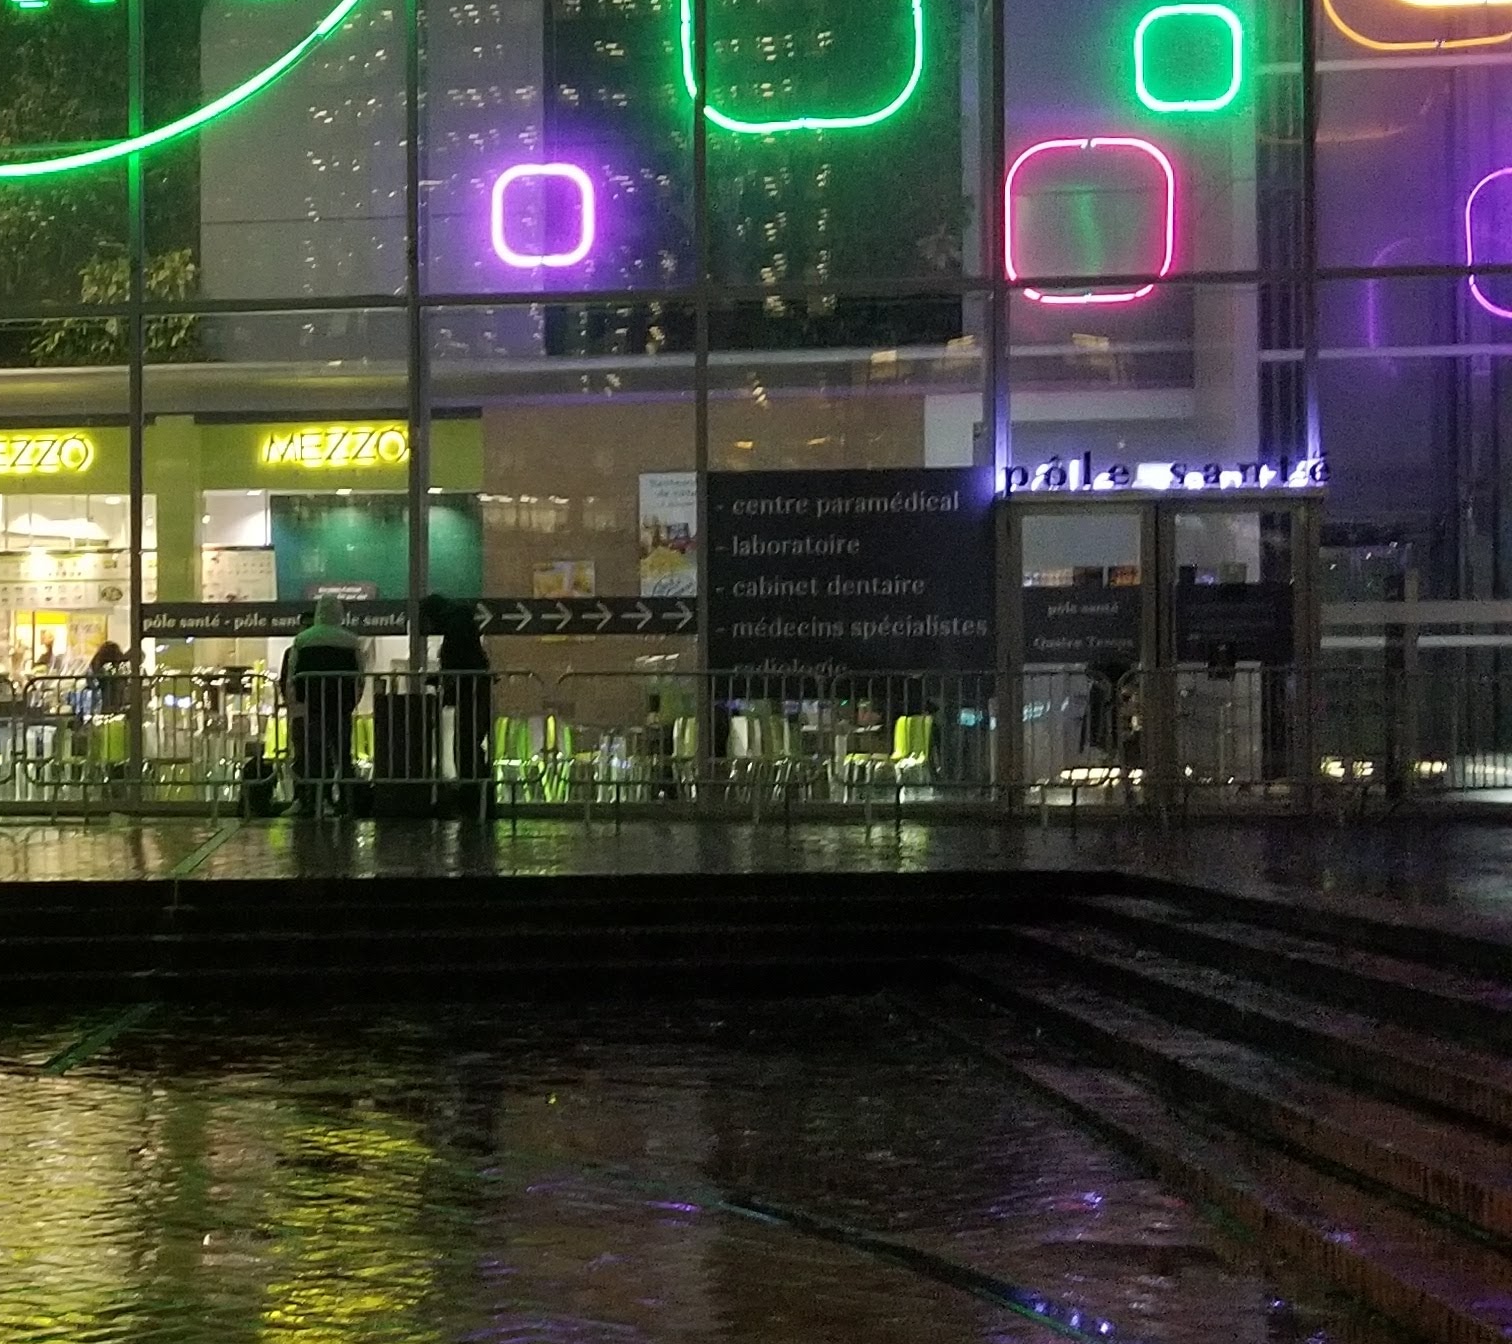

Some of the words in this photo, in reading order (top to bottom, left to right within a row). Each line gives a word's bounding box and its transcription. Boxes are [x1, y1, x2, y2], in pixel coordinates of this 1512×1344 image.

[262, 426, 410, 467] MEZZO
[1004, 451, 1131, 498] pôle
[732, 495, 809, 516] centre
[816, 490, 960, 518] paramédical
[732, 534, 861, 556] laboratoire
[732, 575, 819, 598] cabinet
[827, 574, 926, 596] dentaire
[142, 612, 176, 632] pôle
[178, 612, 221, 629] santé
[233, 611, 267, 631] pôle
[363, 611, 407, 627] santé
[732, 616, 845, 639] médecins
[850, 613, 988, 641] spécialistes
